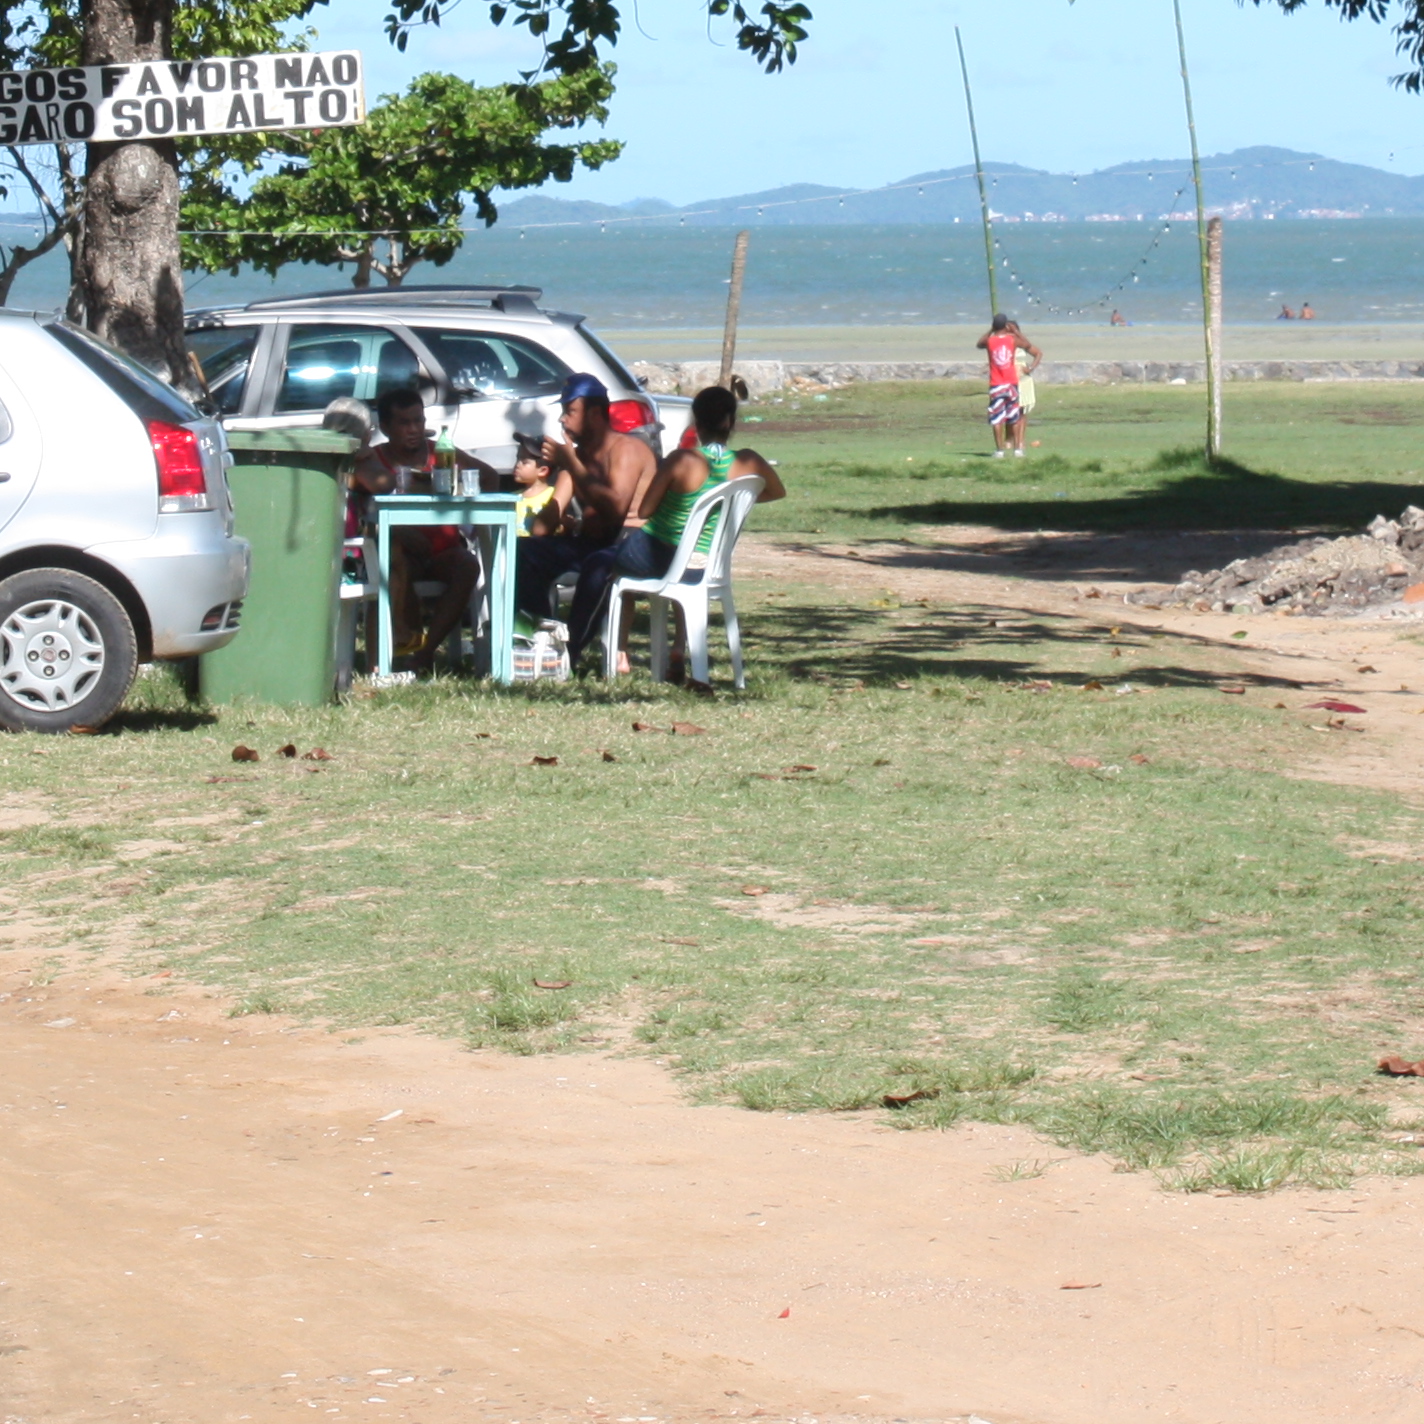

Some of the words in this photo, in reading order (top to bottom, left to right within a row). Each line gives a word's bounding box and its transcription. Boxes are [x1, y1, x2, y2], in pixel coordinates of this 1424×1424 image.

[101, 60, 258, 99] FAVOR
[275, 54, 358, 88] NAO
[111, 96, 205, 138] SOM
